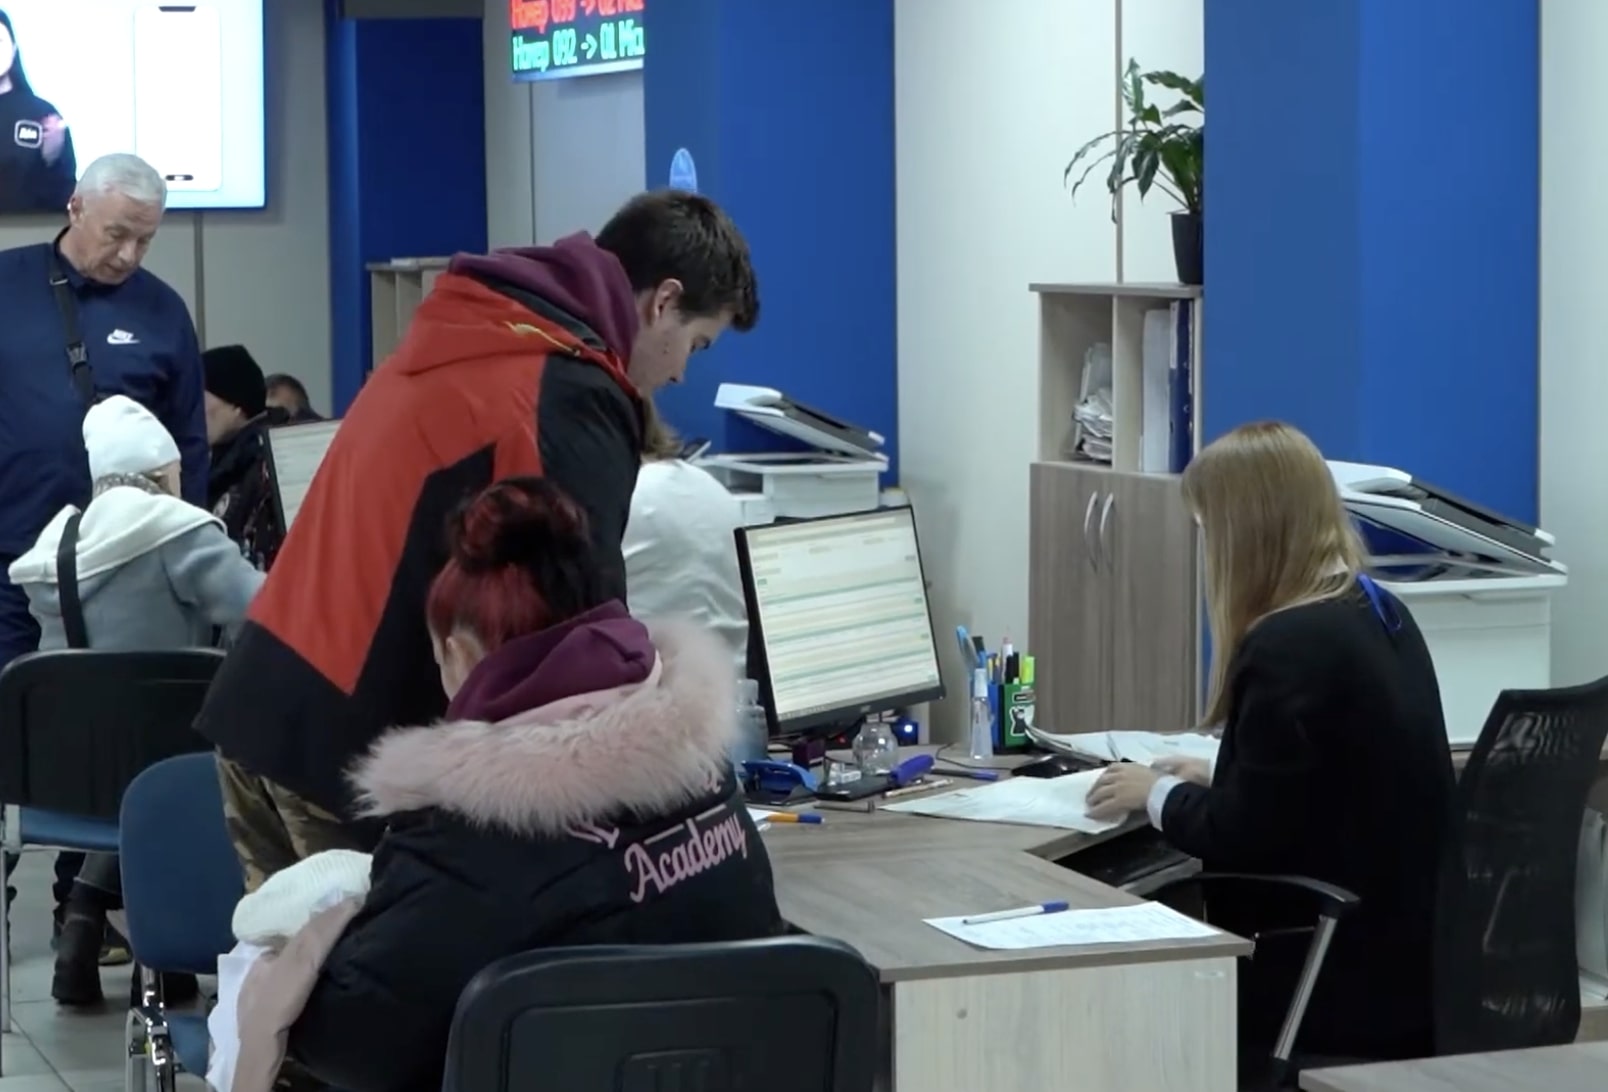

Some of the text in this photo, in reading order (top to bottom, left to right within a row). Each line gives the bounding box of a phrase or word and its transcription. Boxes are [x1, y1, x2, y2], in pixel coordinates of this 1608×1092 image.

[512, 36, 550, 72] Номер
[552, 28, 578, 66] 092
[600, 22, 617, 59] 01
[624, 813, 748, 903] Academy
